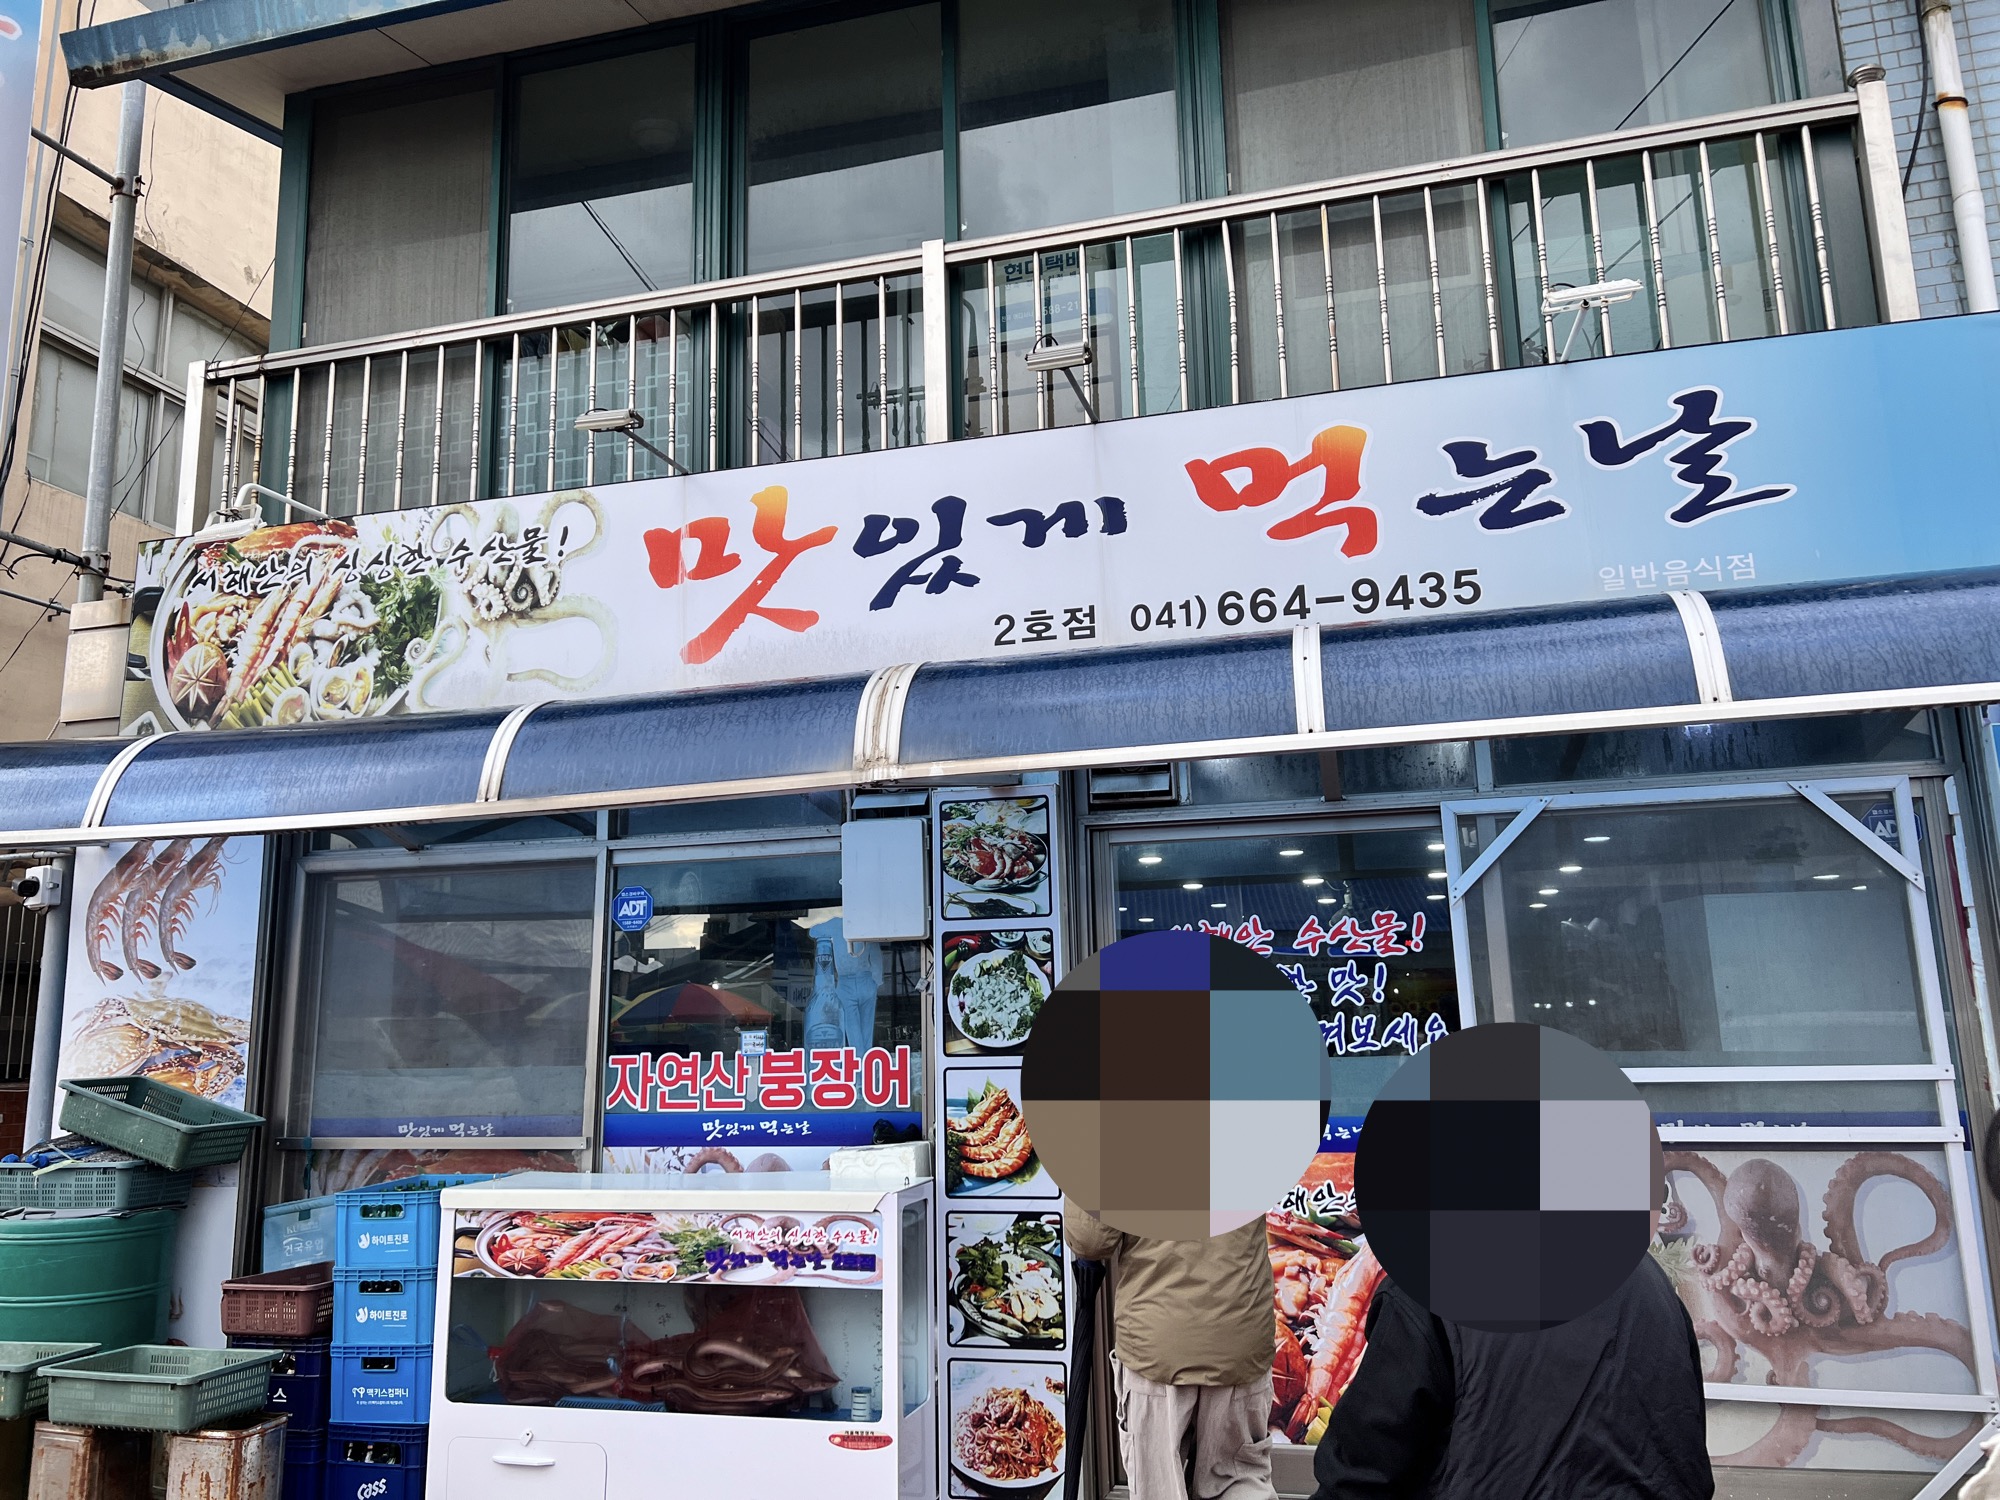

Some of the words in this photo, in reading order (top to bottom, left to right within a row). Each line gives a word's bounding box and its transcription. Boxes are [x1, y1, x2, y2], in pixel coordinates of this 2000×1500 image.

[643, 485, 1127, 664] 맛있게
[1184, 389, 1794, 558] 먹는날
[192, 556, 314, 594] 서해안의
[332, 543, 432, 584] 싱싱한
[445, 524, 569, 569] 수산물!
[1598, 552, 1757, 592] 일반음식점
[993, 604, 1097, 647] 2호점
[1874, 819, 1900, 838] AD
[618, 900, 648, 917] ADT
[1292, 910, 1426, 957] 수산물!
[1328, 959, 1387, 1007] 맛!
[605, 1051, 752, 1113] 자연산
[757, 1045, 911, 1110] 붕장어
[397, 1122, 445, 1138] 맛있게
[702, 1118, 755, 1141] 맛있게
[759, 1119, 813, 1136] 먹는날
[371, 1234, 410, 1245] 하이트진로
[731, 1228, 782, 1241] 서해안의
[832, 1229, 878, 1245] 수산물!
[369, 1311, 408, 1321] 하이트진로
[267, 1387, 287, 1403] 스
[366, 1388, 409, 1398] 맥키스컴퍼니
